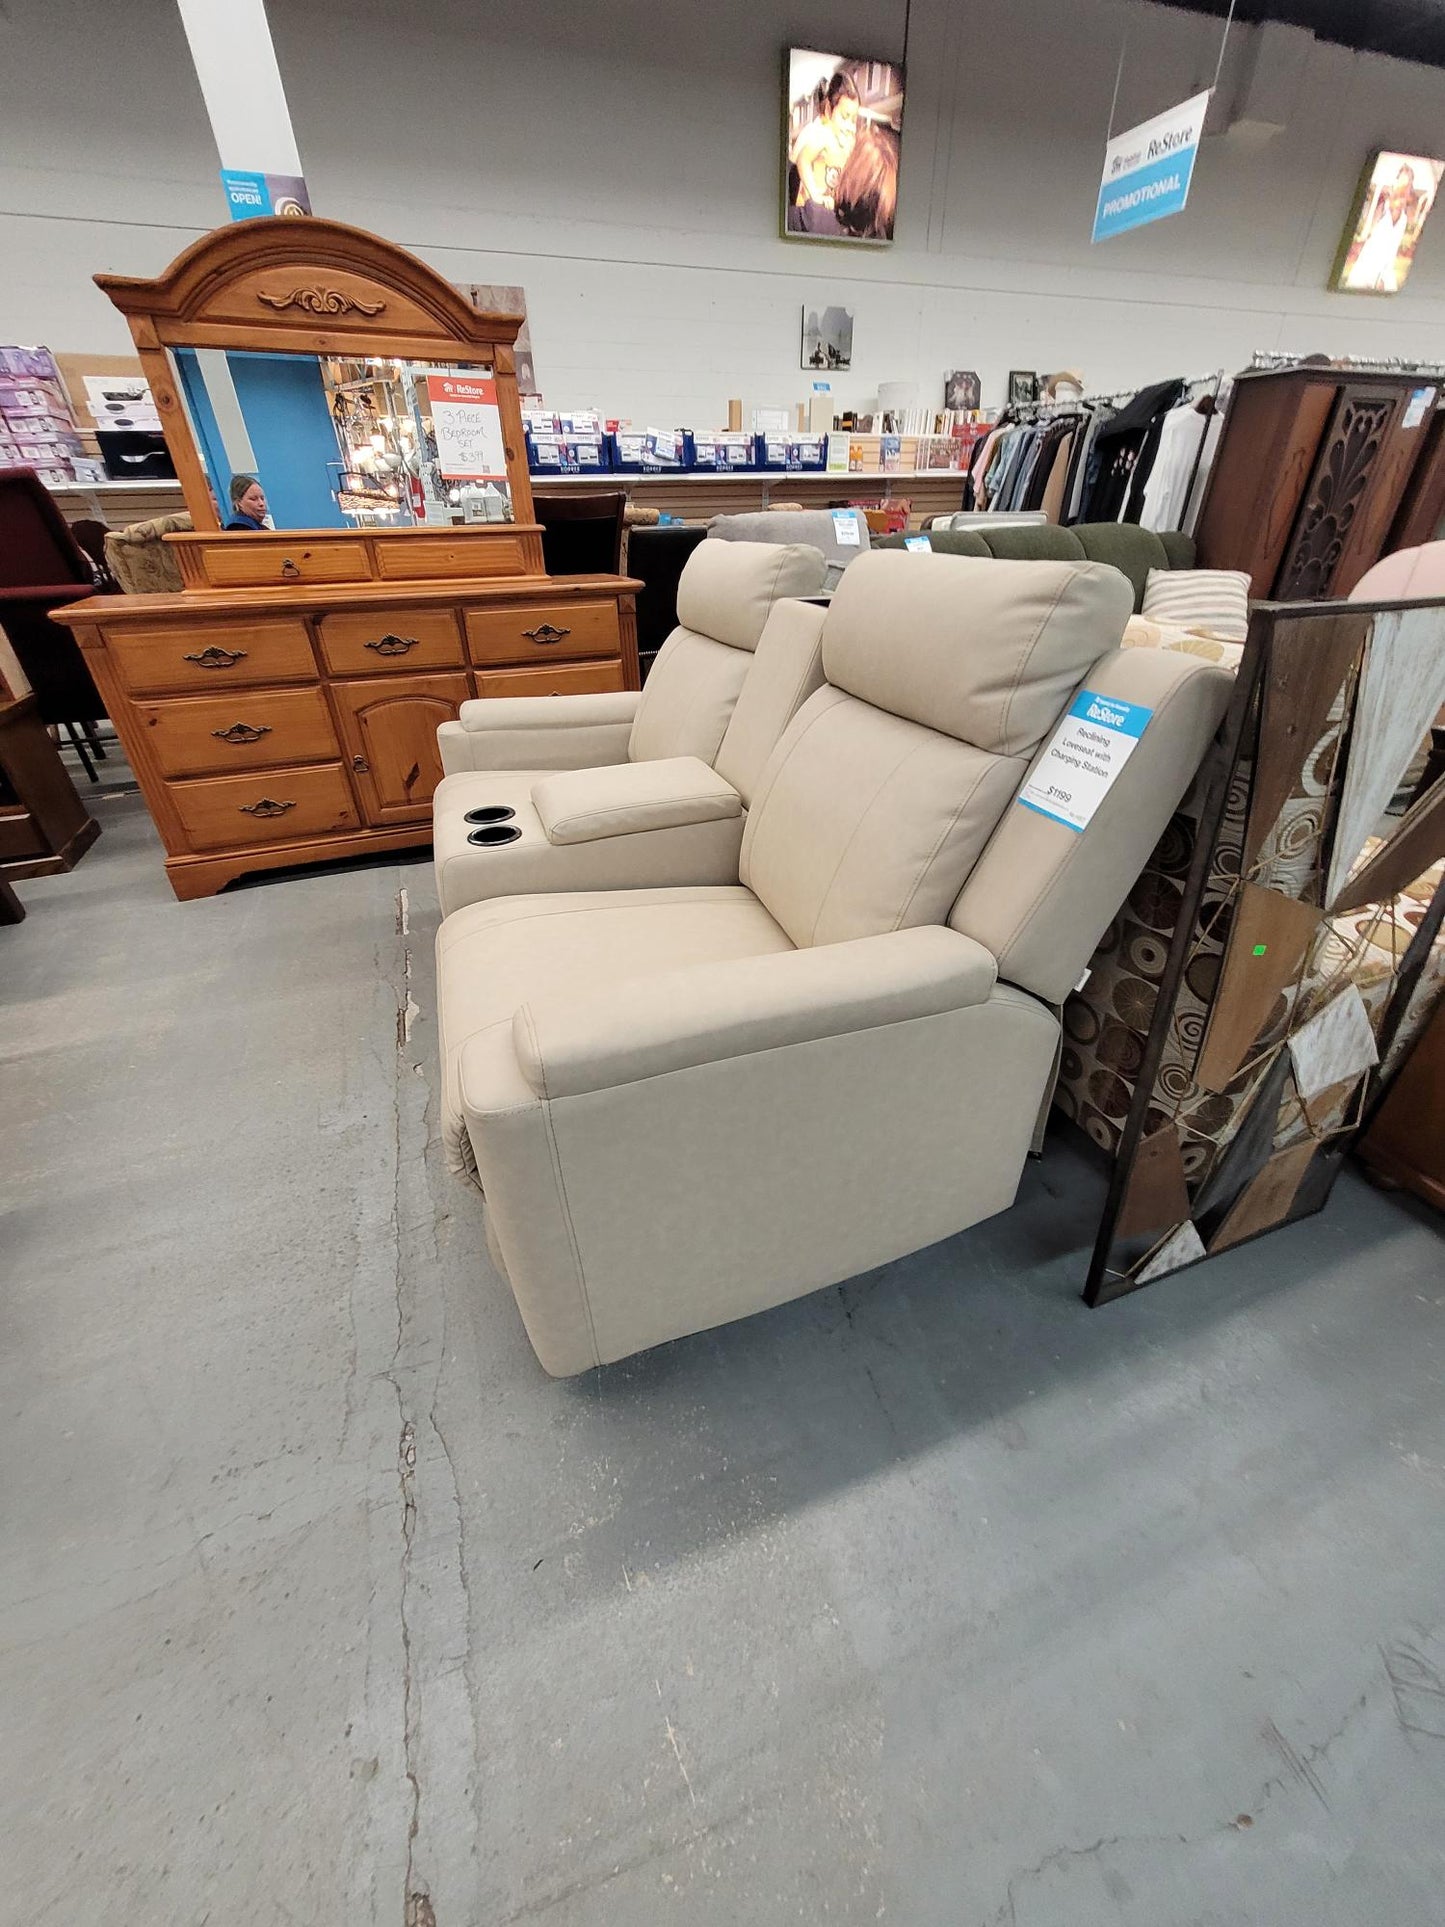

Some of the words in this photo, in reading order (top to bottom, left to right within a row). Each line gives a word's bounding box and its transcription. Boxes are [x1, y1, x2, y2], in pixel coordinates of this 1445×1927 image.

[1147, 125, 1193, 160] ReStore
[231, 192, 262, 205] OPEN!
[1102, 173, 1181, 219] PROMOTIONAL
[456, 384, 484, 396] ReStore
[443, 410, 455, 425] 3
[1086, 703, 1126, 727] ReStore
[1076, 727, 1111, 748] Reclining
[1062, 737, 1095, 757] Loveseat
[1095, 750, 1112, 762] with
[1050, 748, 1082, 768] Charging
[1081, 760, 1109, 778] Station
[1047, 785, 1073, 803] $1199
